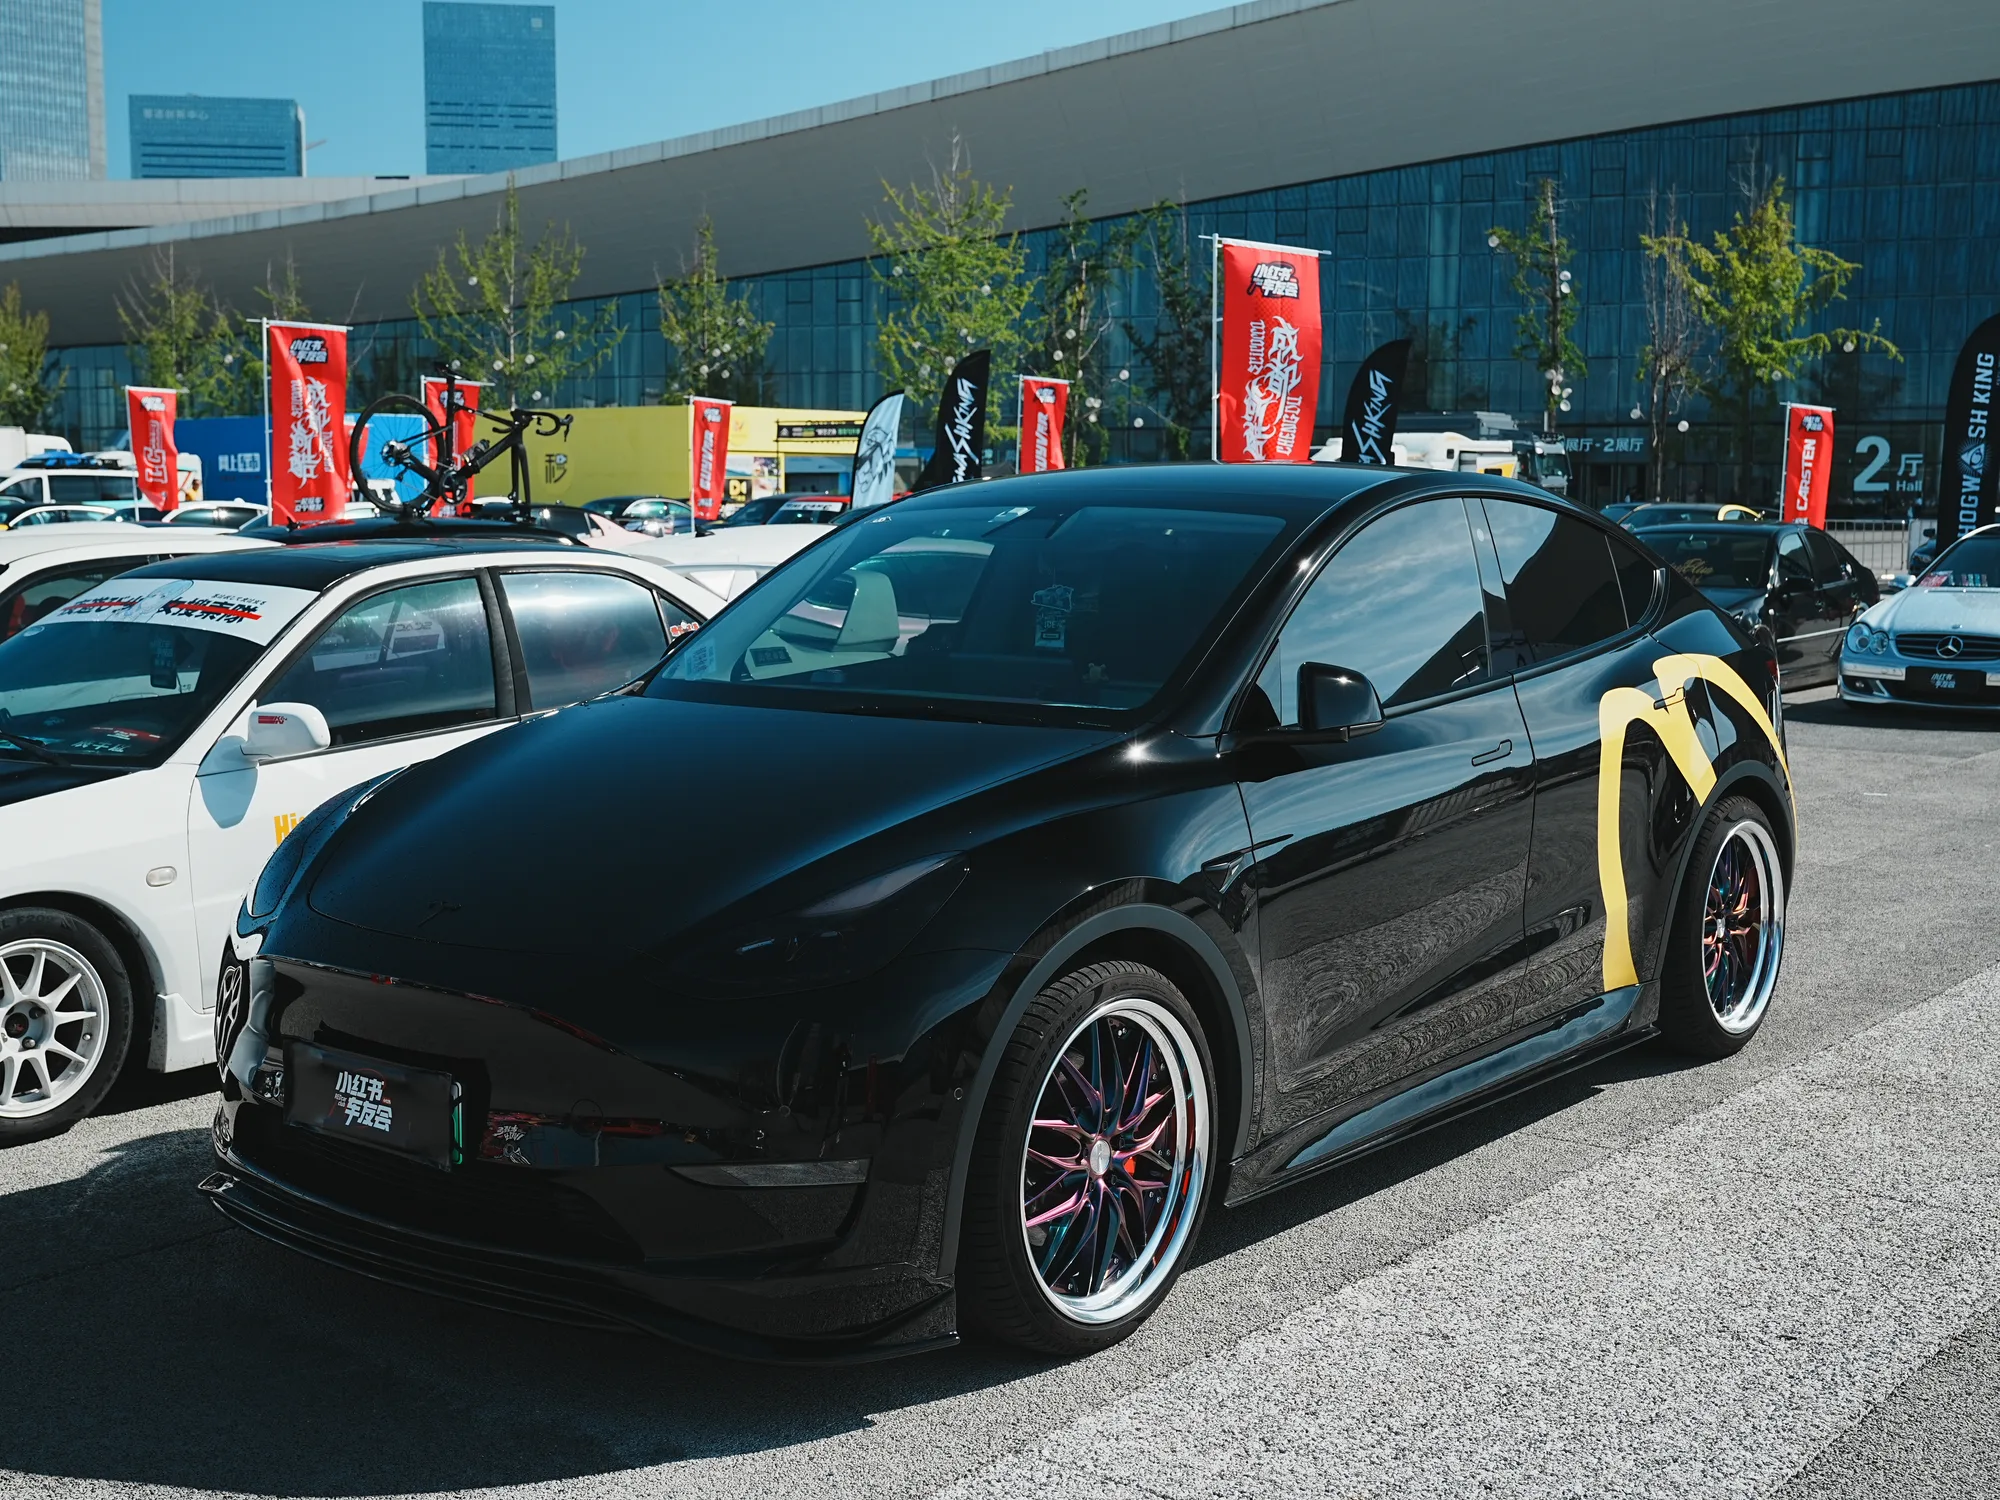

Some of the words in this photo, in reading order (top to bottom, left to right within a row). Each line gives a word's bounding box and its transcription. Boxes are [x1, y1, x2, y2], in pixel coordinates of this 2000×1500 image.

[1253, 264, 1293, 281] 小红书
[1262, 279, 1298, 297] 车友会
[1796, 439, 1817, 511] CARSTEN
[1854, 435, 1891, 492] 2
[1897, 453, 1923, 476] 厅
[1896, 480, 1922, 492] Hall
[274, 812, 304, 847] Hi
[335, 1071, 385, 1101] 小红书
[344, 1097, 393, 1132] 车友会
